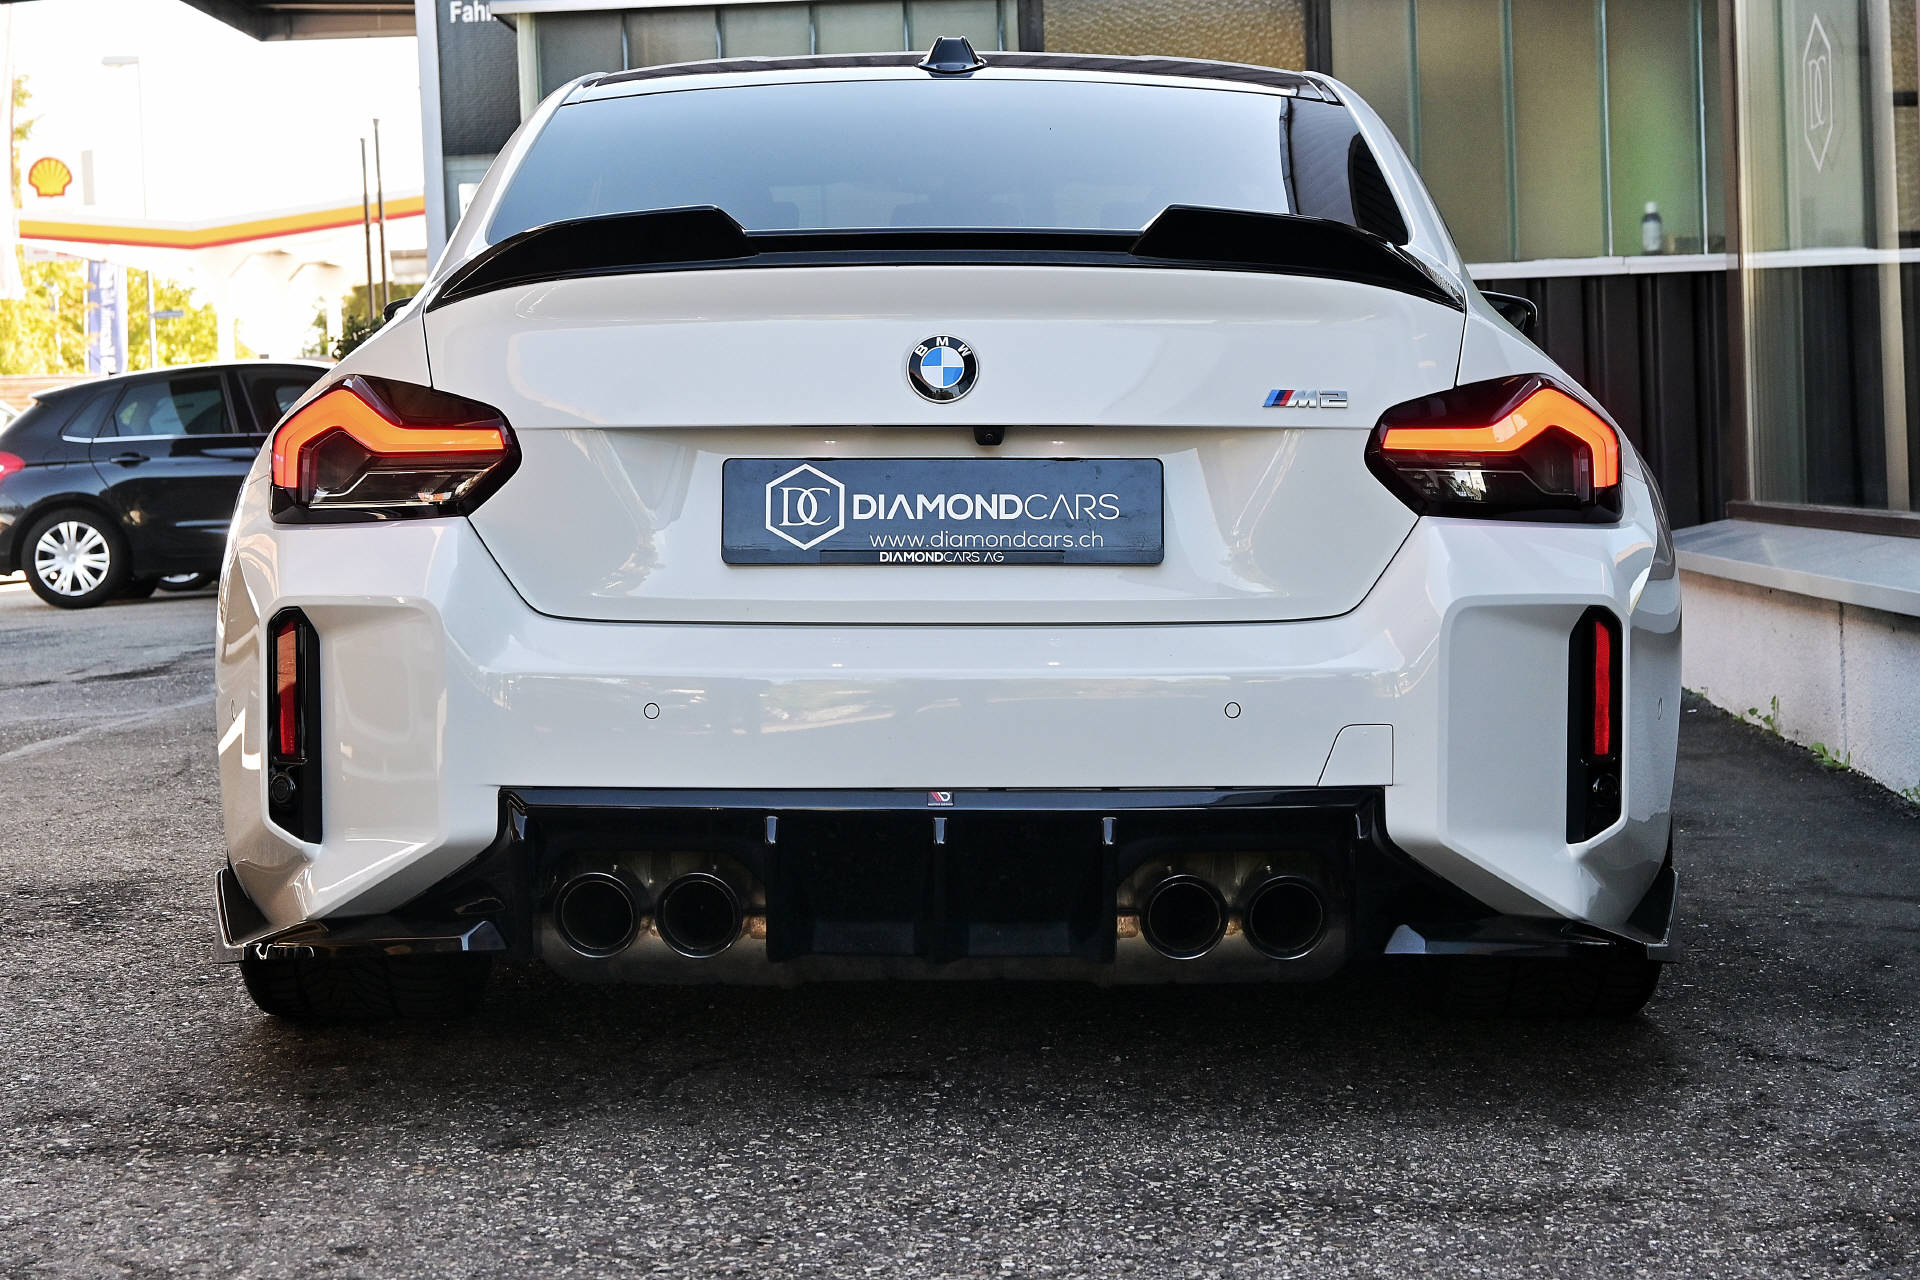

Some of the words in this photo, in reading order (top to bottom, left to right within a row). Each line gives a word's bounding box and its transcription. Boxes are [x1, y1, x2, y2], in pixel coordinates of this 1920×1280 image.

[914, 336, 971, 357] BMW
[1285, 389, 1348, 408] M2
[778, 487, 832, 527] DC
[852, 493, 1120, 520] DIAMONDCARS
[869, 530, 1104, 548] www.diamondcars.ch
[879, 551, 980, 563] DIAMONDCARS
[983, 551, 1004, 563] AG
